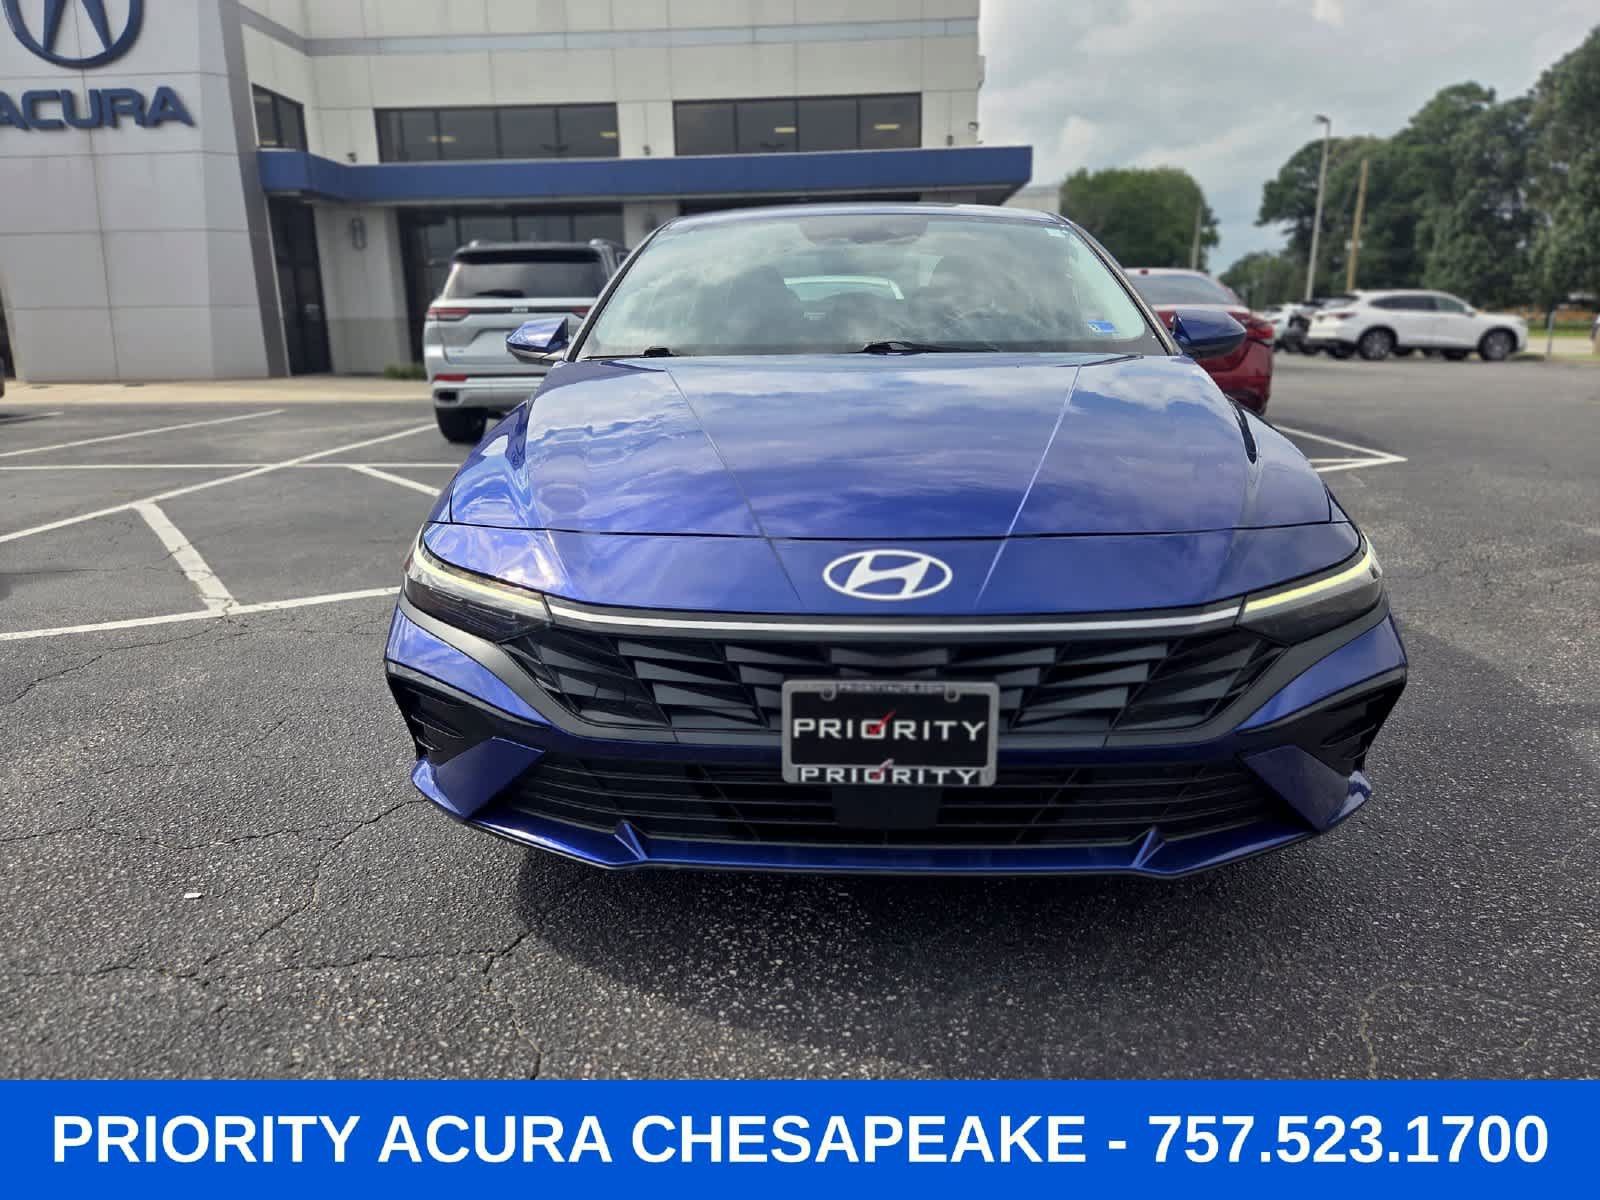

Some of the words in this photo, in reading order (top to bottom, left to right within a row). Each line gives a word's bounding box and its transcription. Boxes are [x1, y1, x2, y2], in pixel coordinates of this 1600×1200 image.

[0, 86, 195, 129] ACURA
[793, 717, 986, 741] PRIORITY
[801, 766, 977, 785] PRIORITY
